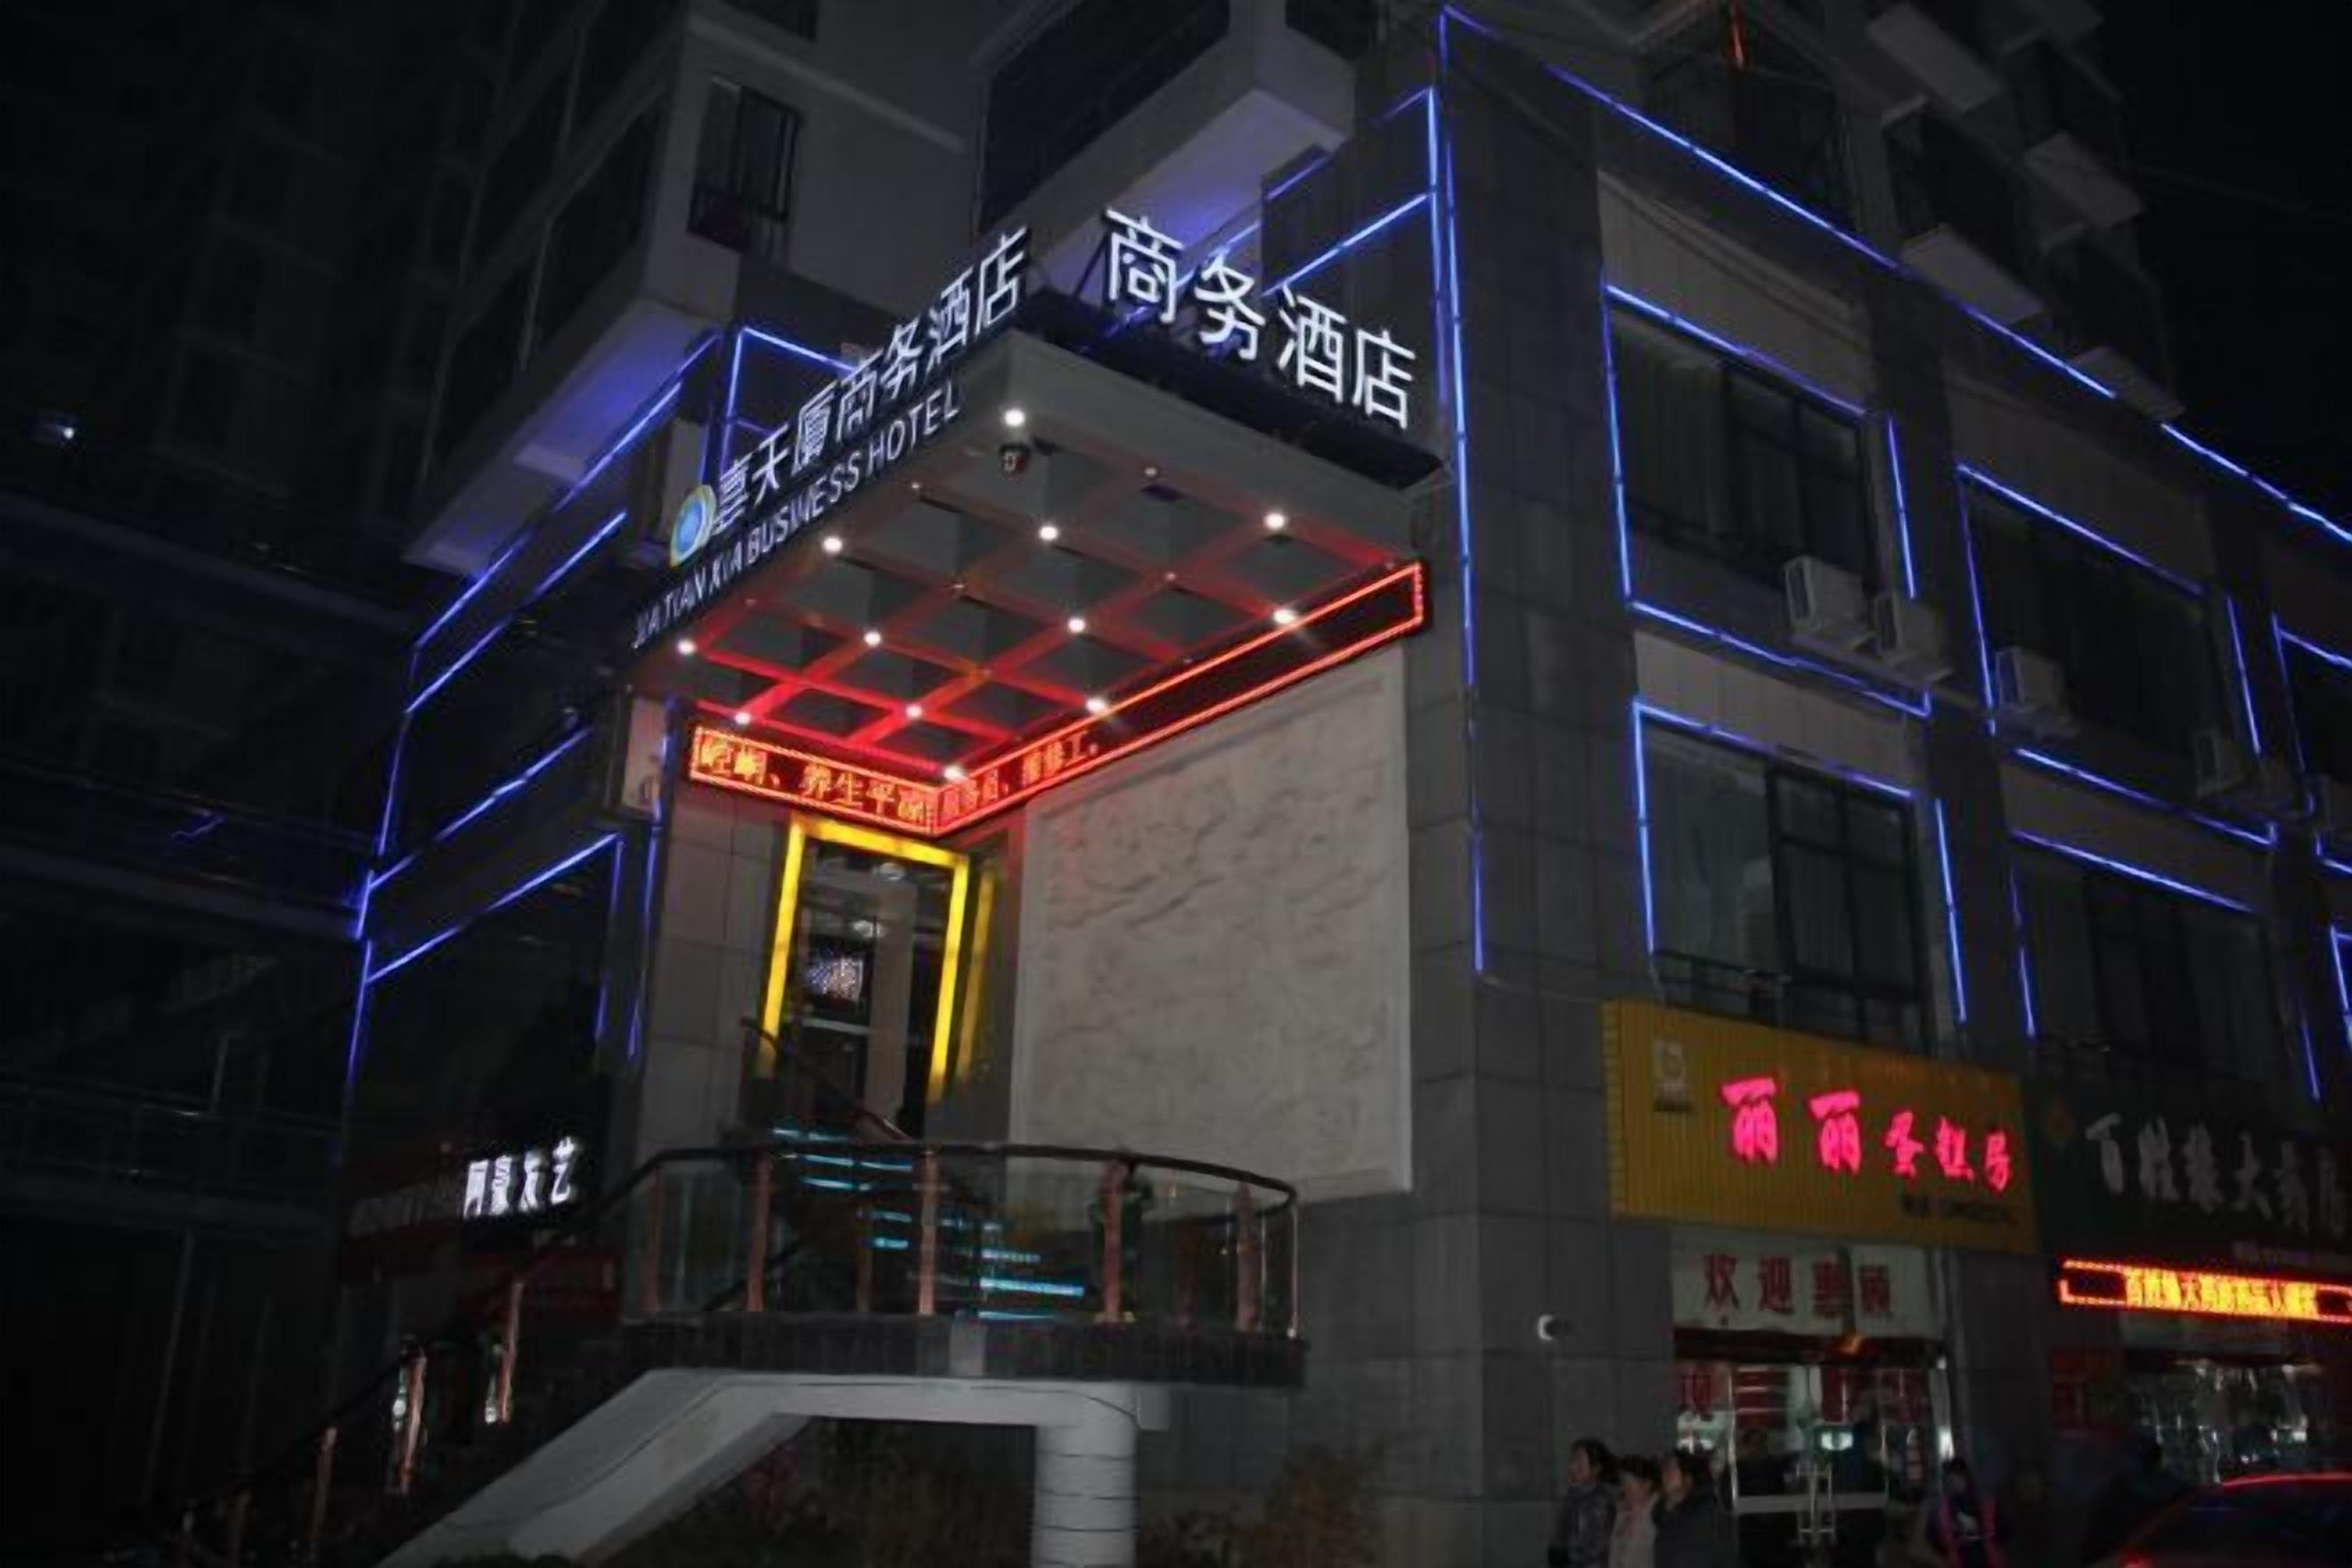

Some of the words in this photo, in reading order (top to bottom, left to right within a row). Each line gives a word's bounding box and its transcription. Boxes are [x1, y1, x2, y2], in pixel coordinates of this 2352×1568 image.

[1105, 208, 1417, 430] 商务酒店
[747, 449, 862, 566] BUSINESS
[867, 381, 961, 478] HOTEL
